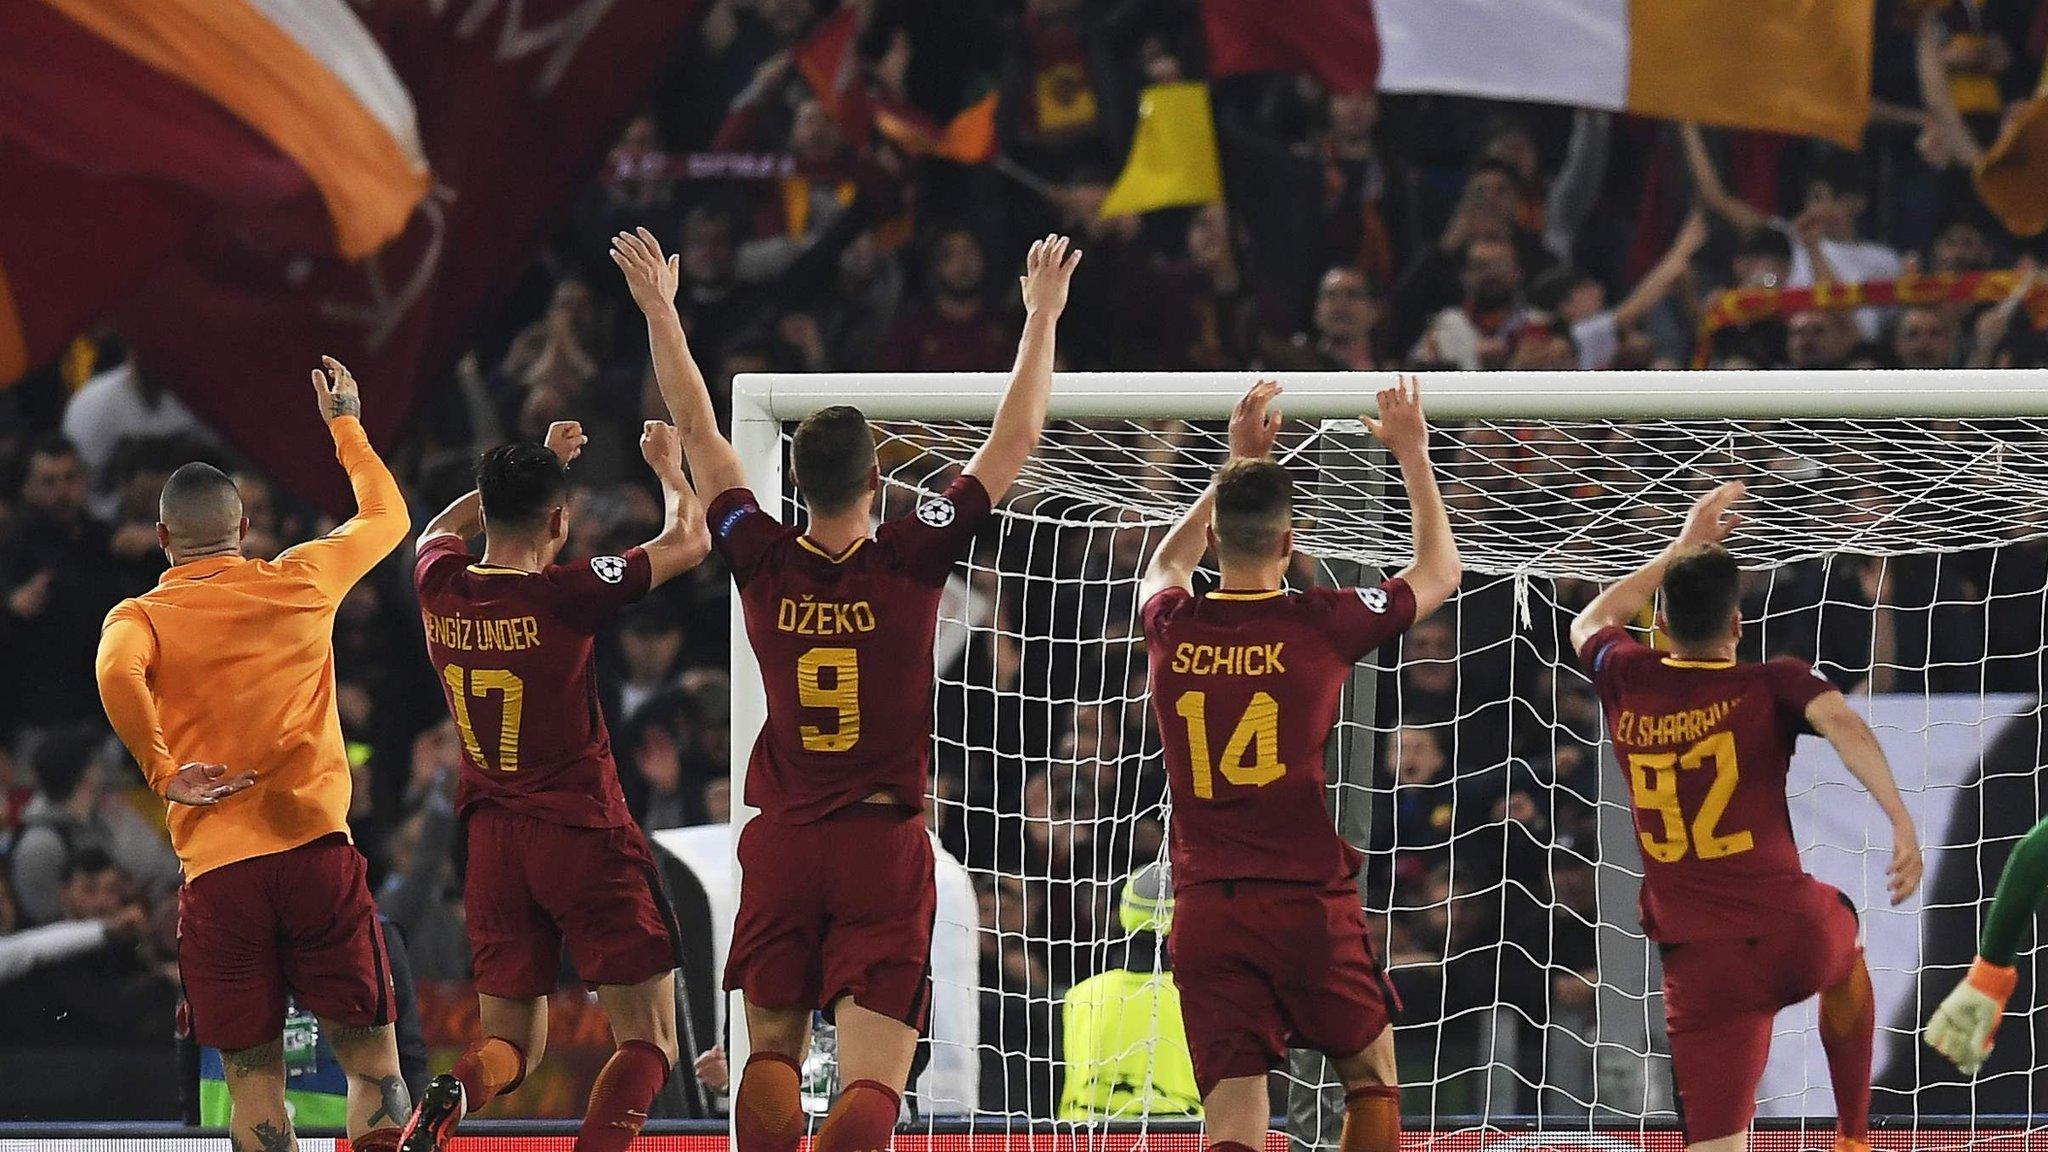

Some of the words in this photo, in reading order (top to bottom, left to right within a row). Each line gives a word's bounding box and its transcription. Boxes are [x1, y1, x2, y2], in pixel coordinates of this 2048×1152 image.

[777, 594, 876, 635] DŽEKO
[1172, 641, 1287, 676] SCHICK
[443, 663, 524, 772] 17
[797, 647, 860, 752] 9
[1176, 690, 1287, 799] 14
[1617, 710, 1635, 746] EL
[1637, 698, 1741, 747] SHAARA
[1628, 731, 1754, 862] 92
